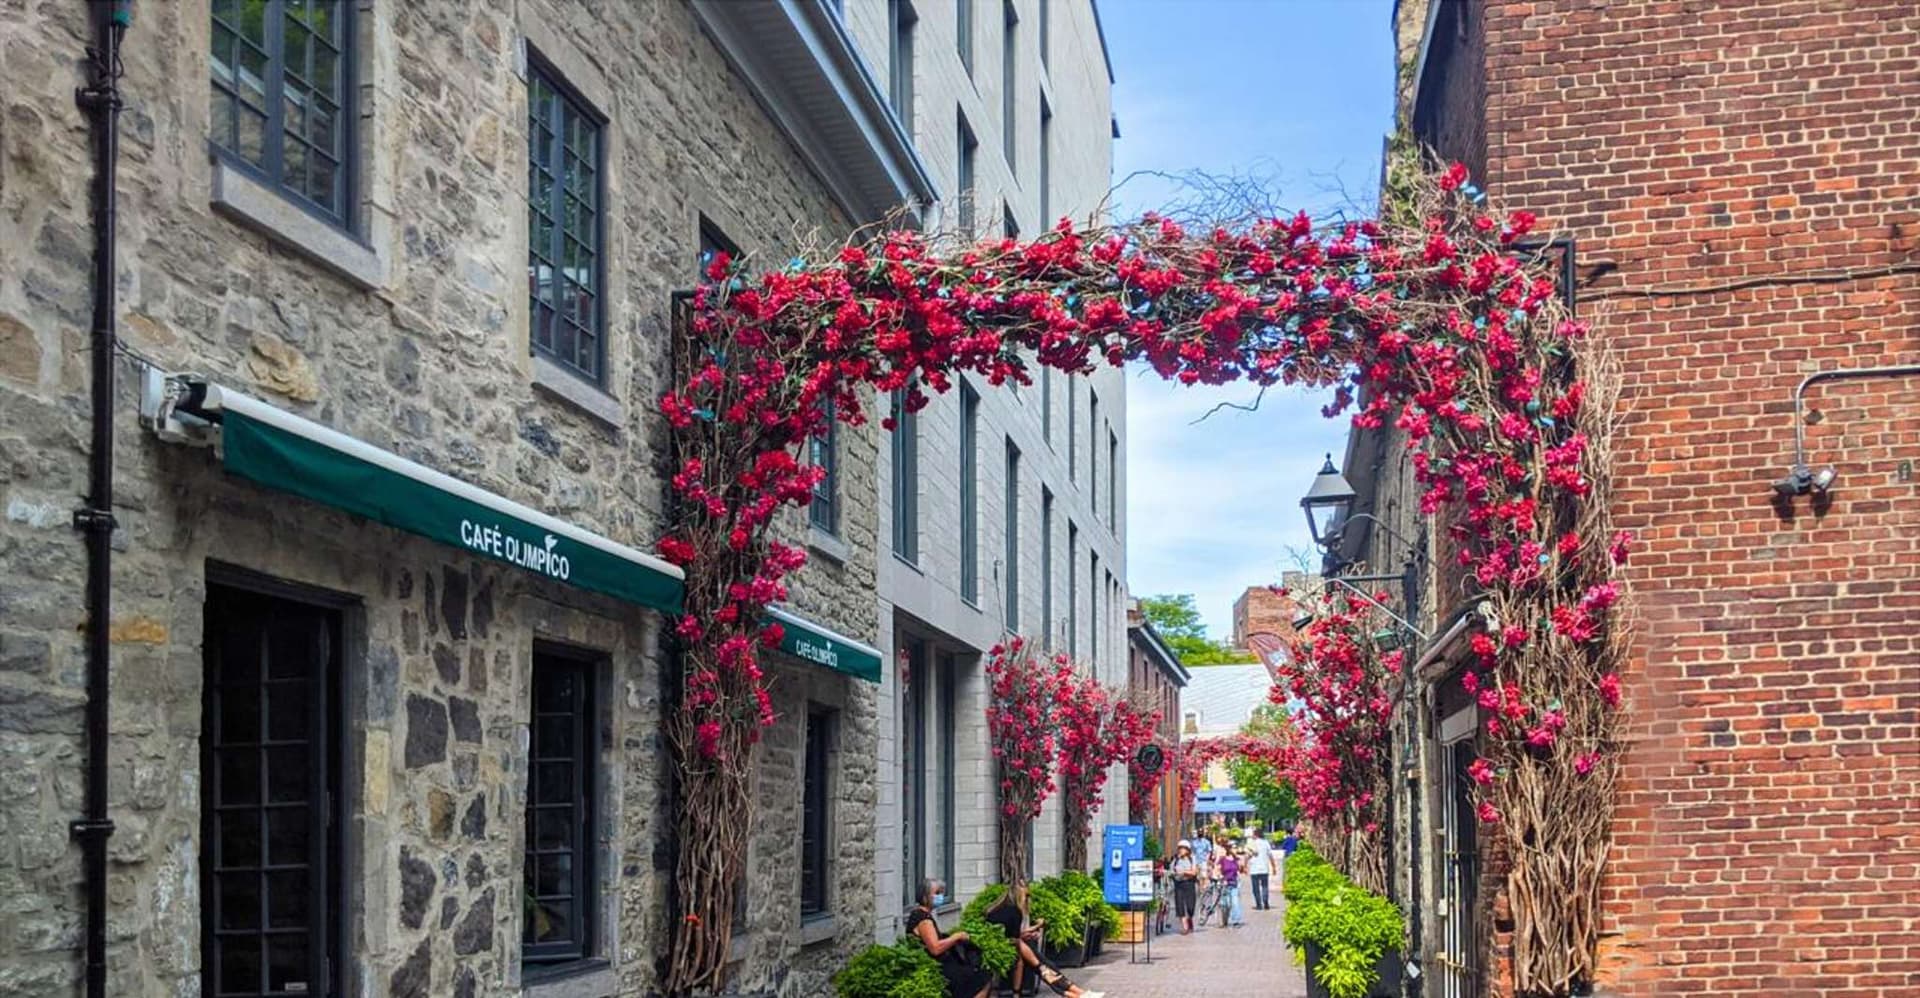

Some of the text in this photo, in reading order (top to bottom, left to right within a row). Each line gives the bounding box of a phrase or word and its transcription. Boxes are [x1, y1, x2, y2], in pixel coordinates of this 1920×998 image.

[461, 520, 570, 580] CAFÉ OLIMPICO
[796, 640, 811, 659] CAFÉ
